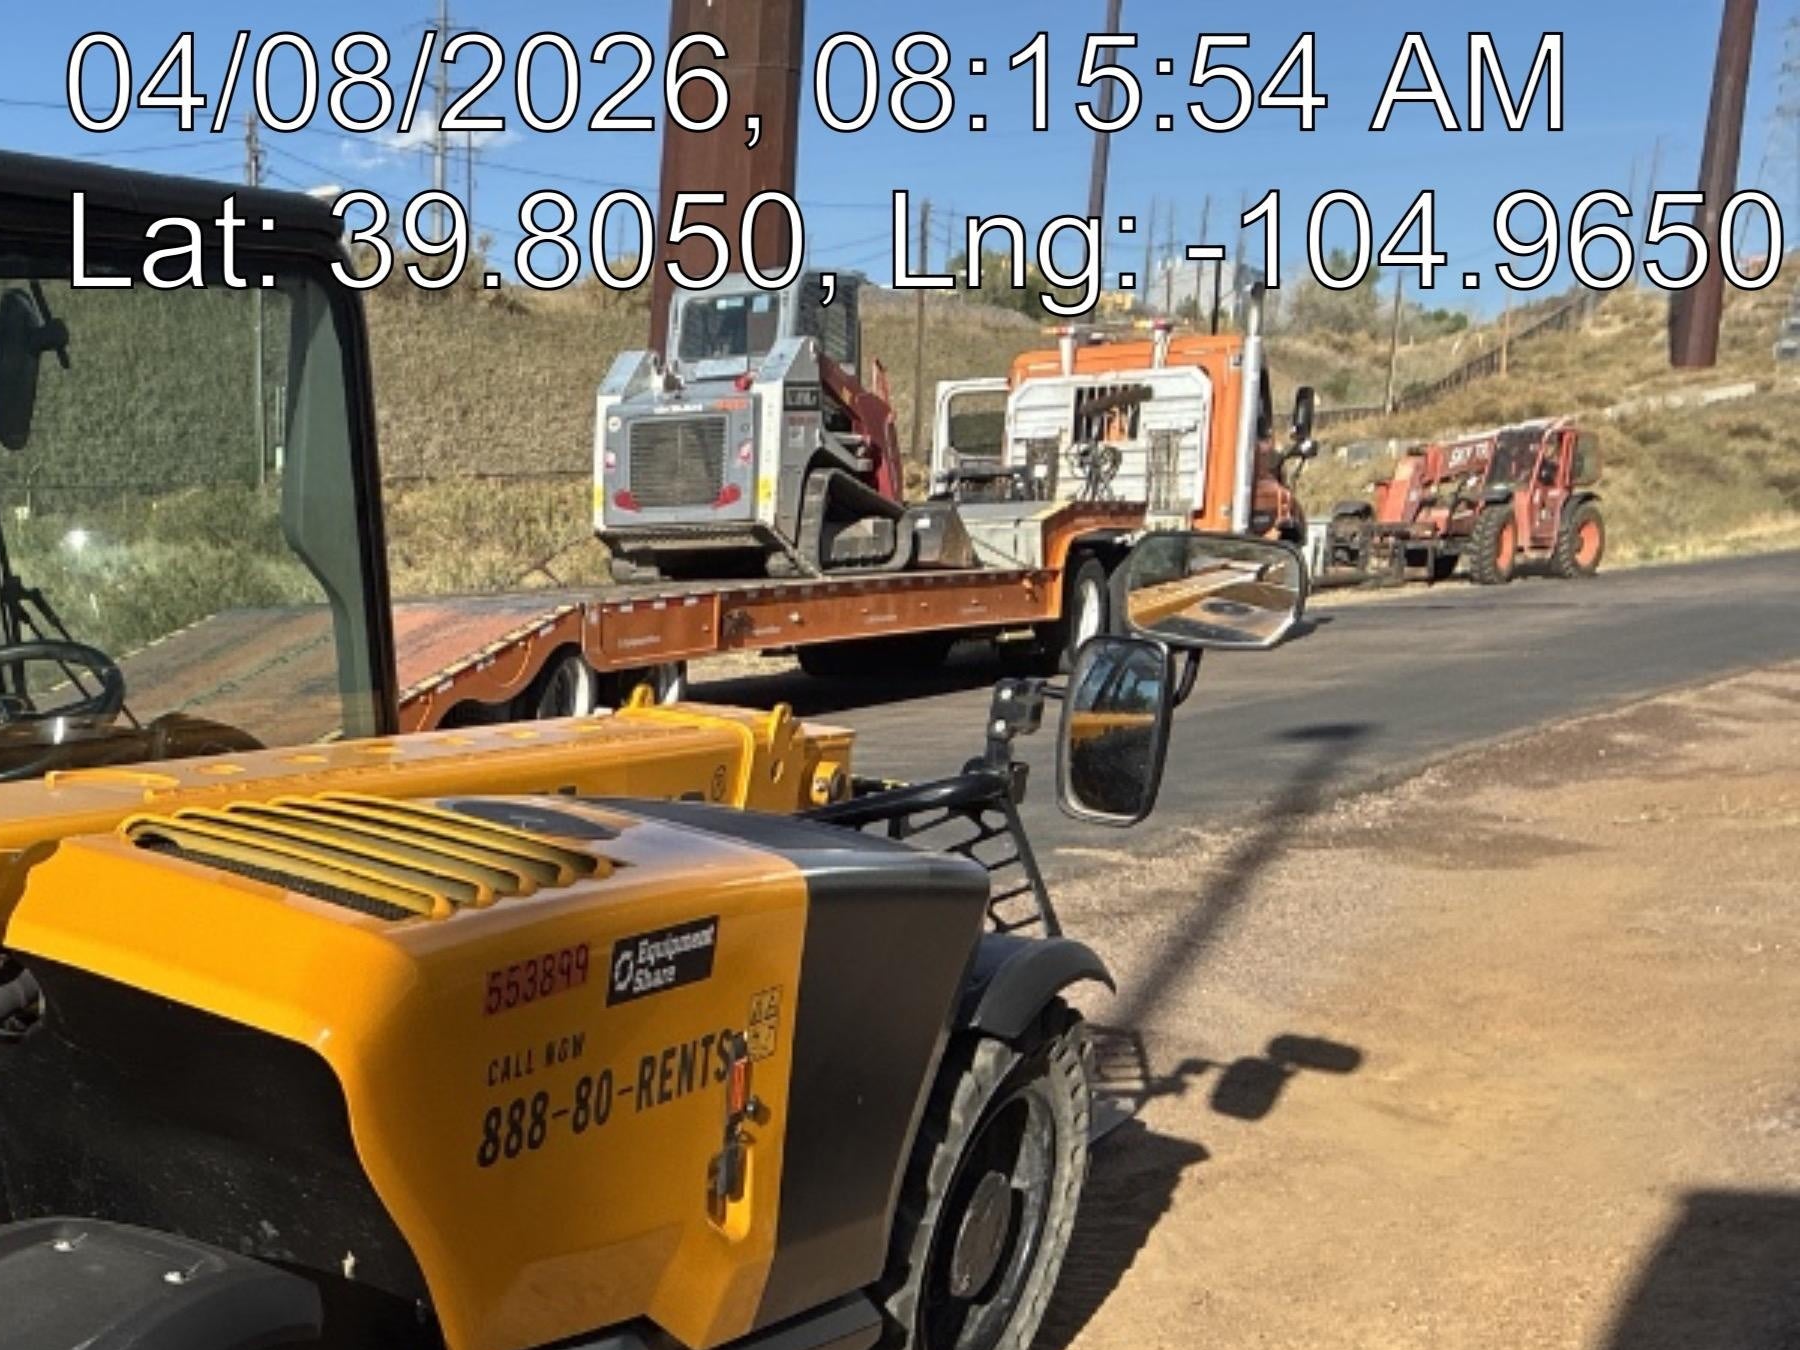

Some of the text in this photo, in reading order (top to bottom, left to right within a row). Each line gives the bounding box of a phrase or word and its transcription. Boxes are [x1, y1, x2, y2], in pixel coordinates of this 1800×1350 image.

[637, 924, 715, 967] Equipment
[485, 943, 590, 1016] 553899
[632, 965, 677, 993] Share
[487, 1031, 586, 1088] CALL NOW
[477, 1028, 733, 1168] 888-80-RENTS
